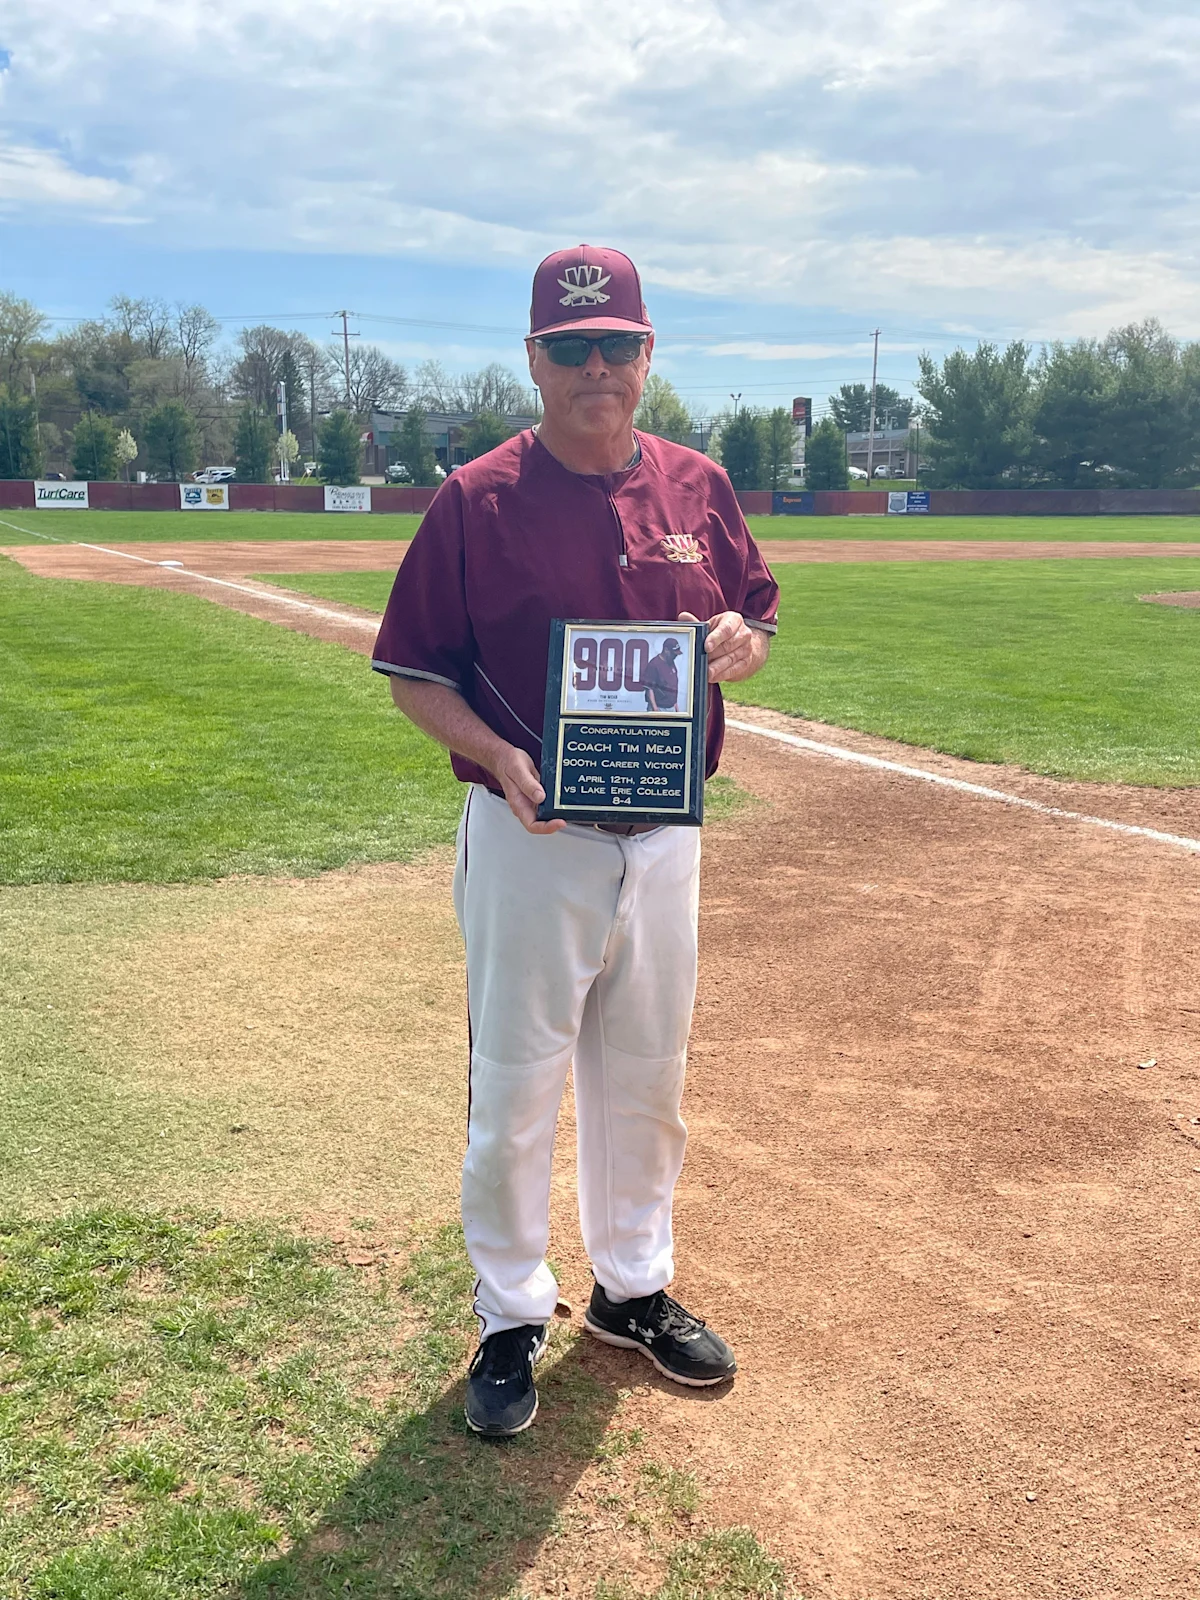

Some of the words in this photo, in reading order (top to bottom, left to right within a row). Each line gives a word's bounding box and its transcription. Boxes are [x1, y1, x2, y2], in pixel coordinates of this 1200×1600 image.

[37, 488, 86, 500] TurfCare
[572, 637, 649, 692] 900
[580, 726, 670, 737] CONGRATULATIONS
[567, 741, 612, 753] COACH
[618, 742, 640, 754] TIM
[645, 743, 682, 755] MEAD
[563, 758, 597, 768] 900TH
[601, 760, 640, 770] CAREER
[644, 761, 685, 770] VICTORY
[578, 774, 606, 784] APRIL
[640, 777, 668, 786] 2023
[581, 786, 606, 795] LAKE
[610, 787, 633, 796] ERIE
[637, 787, 682, 797] COLLEGE
[612, 796, 632, 805] 8-4
